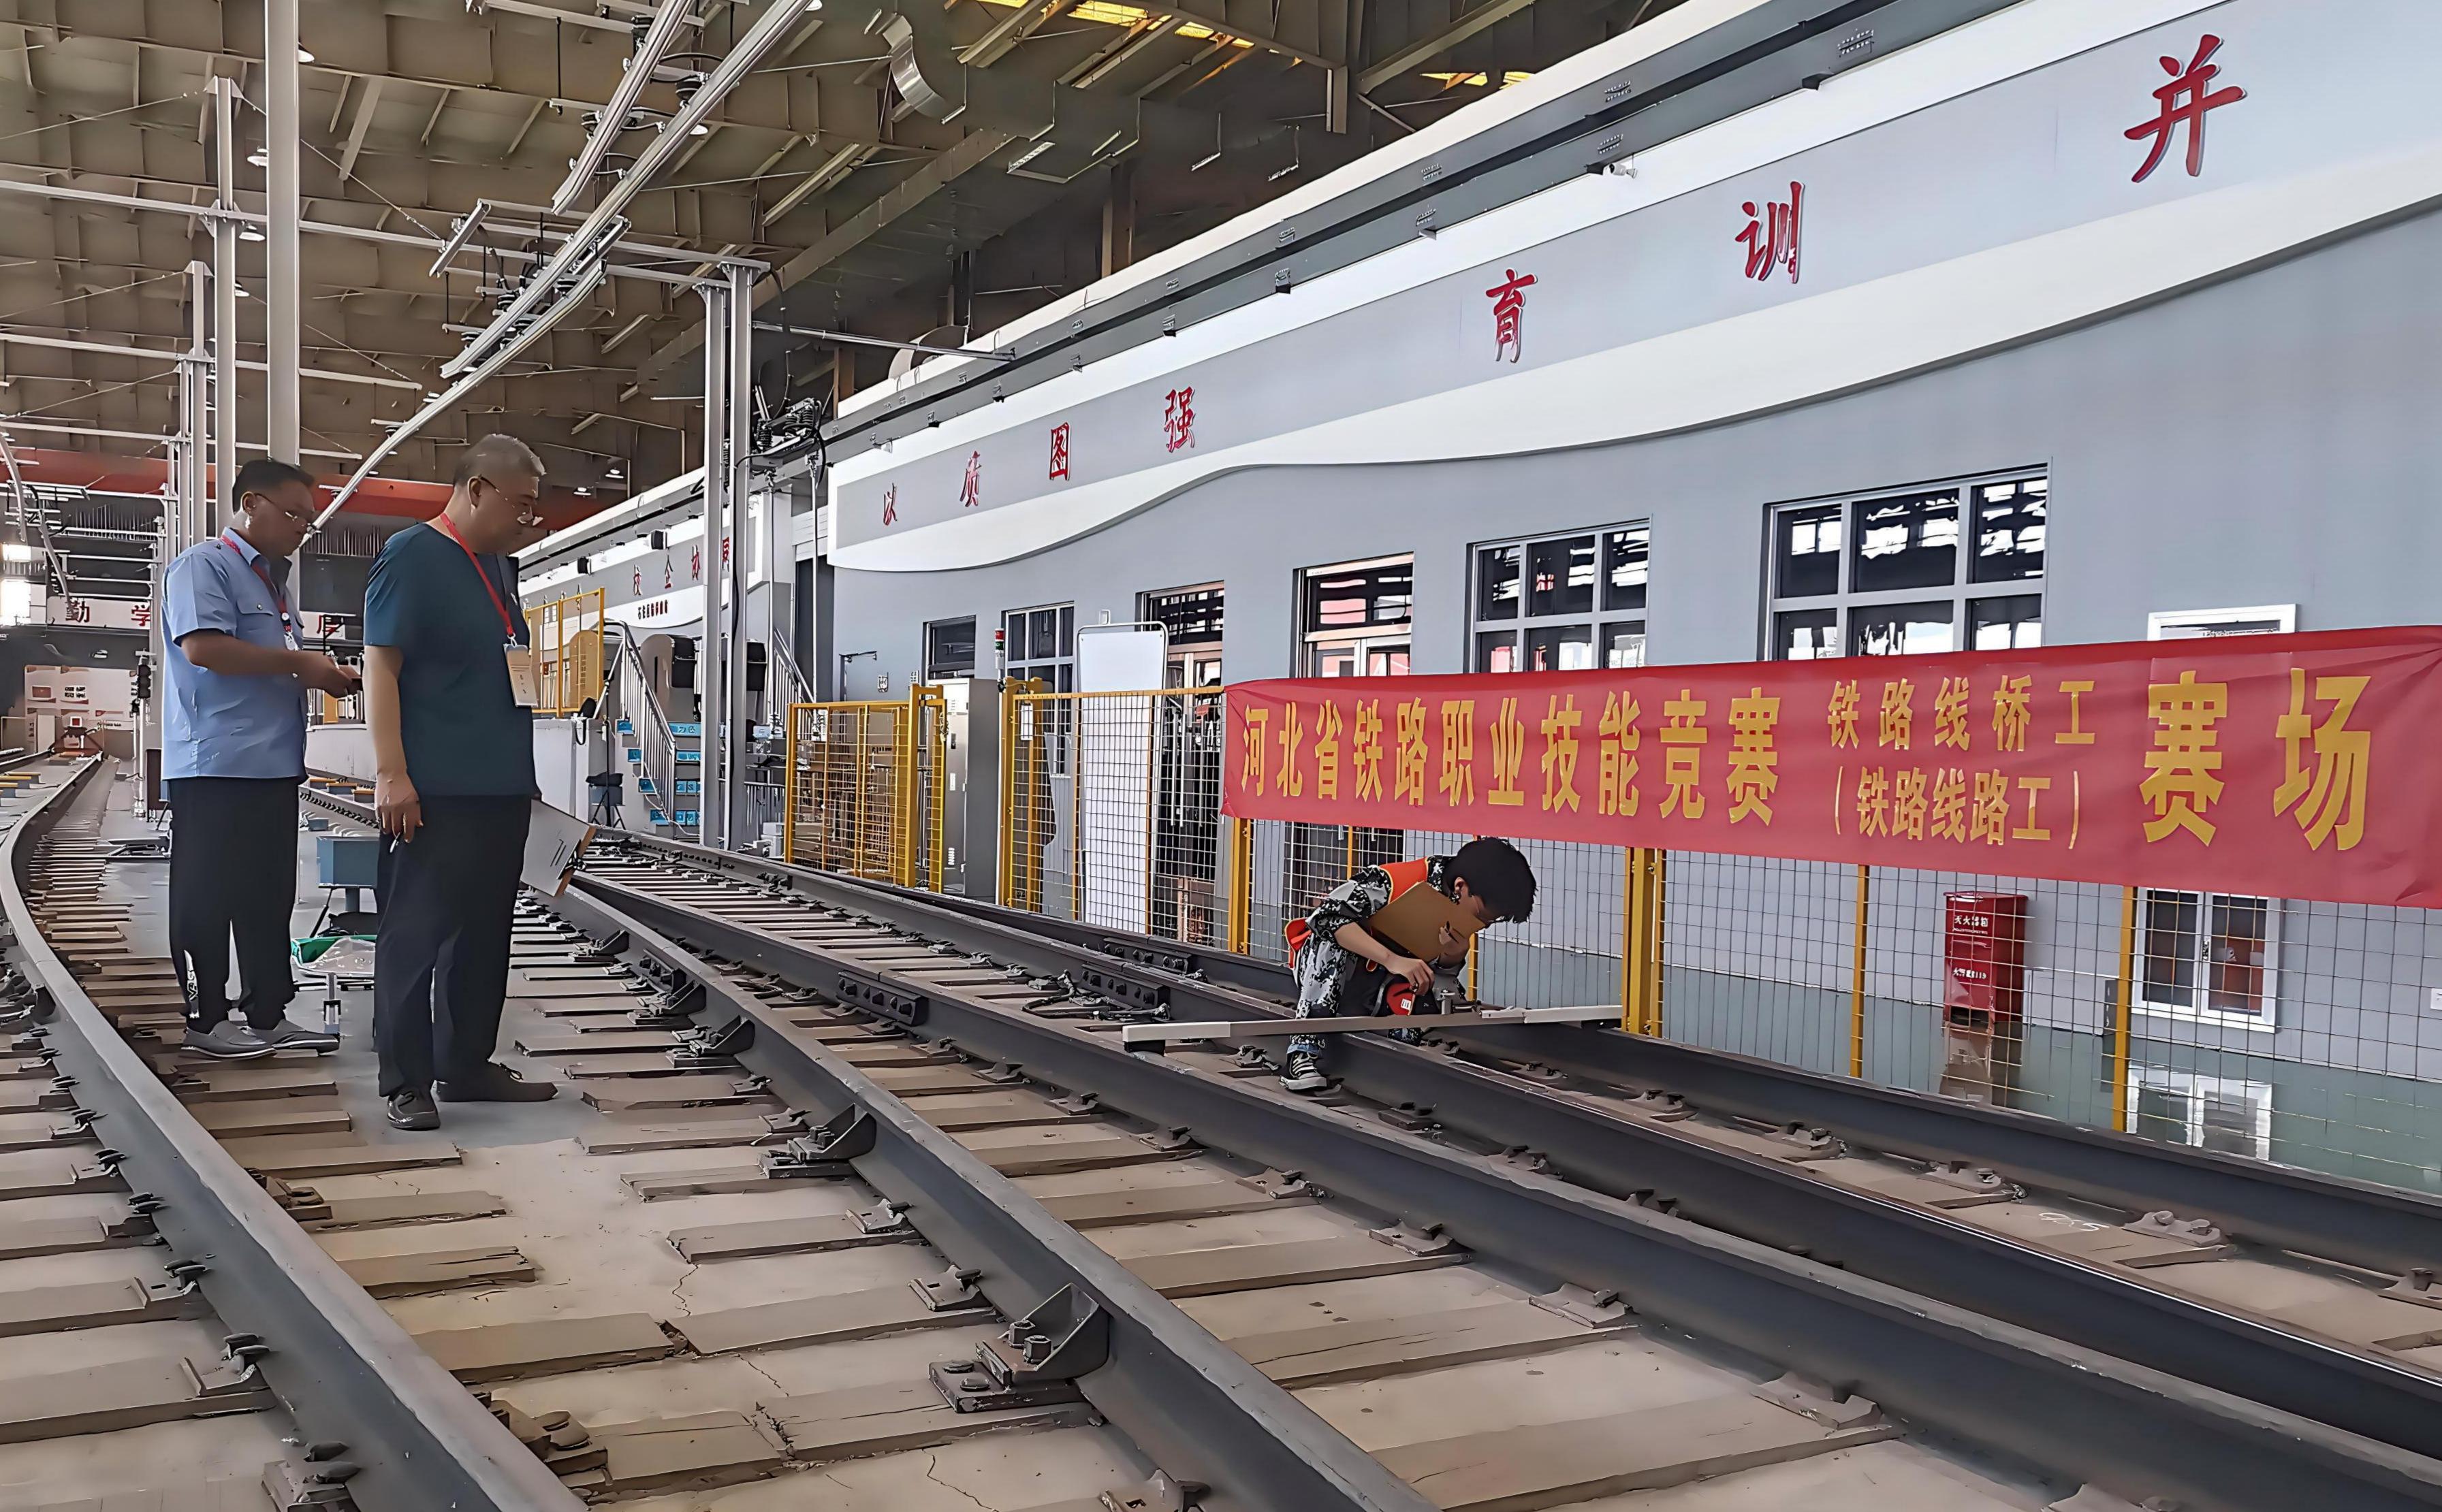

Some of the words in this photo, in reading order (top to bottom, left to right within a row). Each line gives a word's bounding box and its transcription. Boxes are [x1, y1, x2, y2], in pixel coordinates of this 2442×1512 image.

[1241, 687, 1781, 826] 河北省铁路职业技能竞赛
[2138, 668, 2371, 851] 赛场
[1827, 675, 2095, 753] 铁路线桥工
